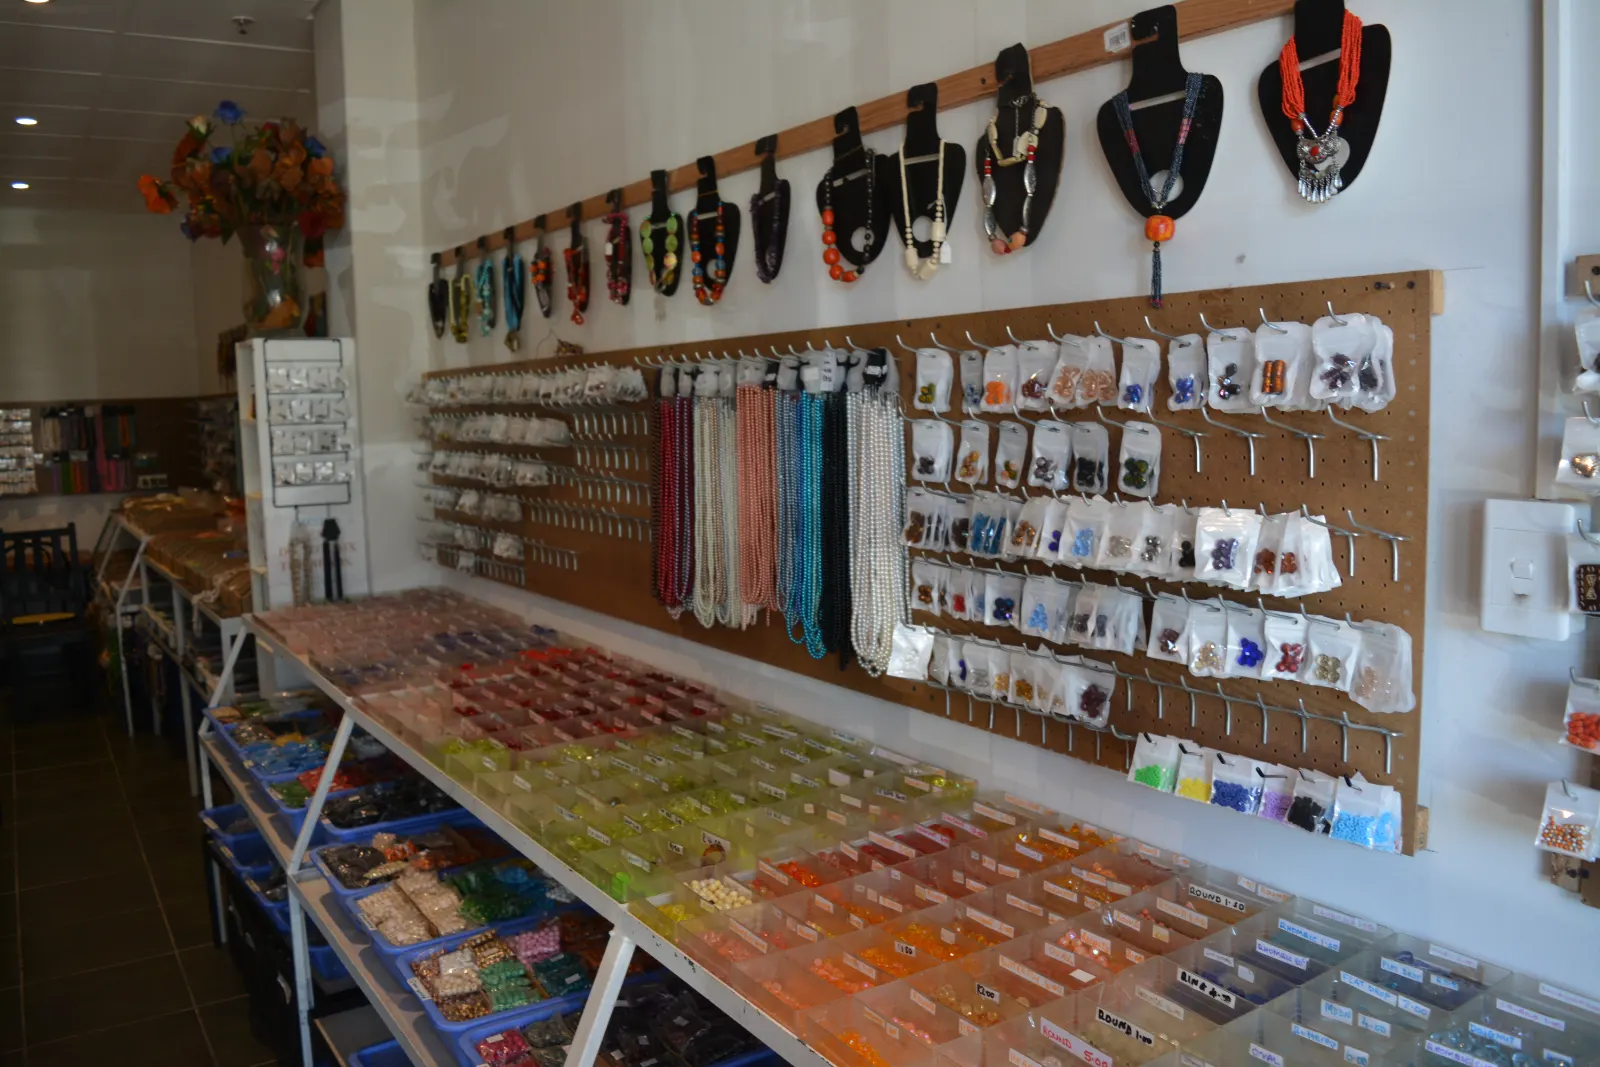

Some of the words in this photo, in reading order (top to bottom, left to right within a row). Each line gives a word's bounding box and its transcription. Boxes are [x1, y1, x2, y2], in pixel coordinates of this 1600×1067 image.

[1190, 886, 1222, 903] ROUND
[1098, 1008, 1133, 1036] ROUND
[1043, 1024, 1073, 1050] ROUND
